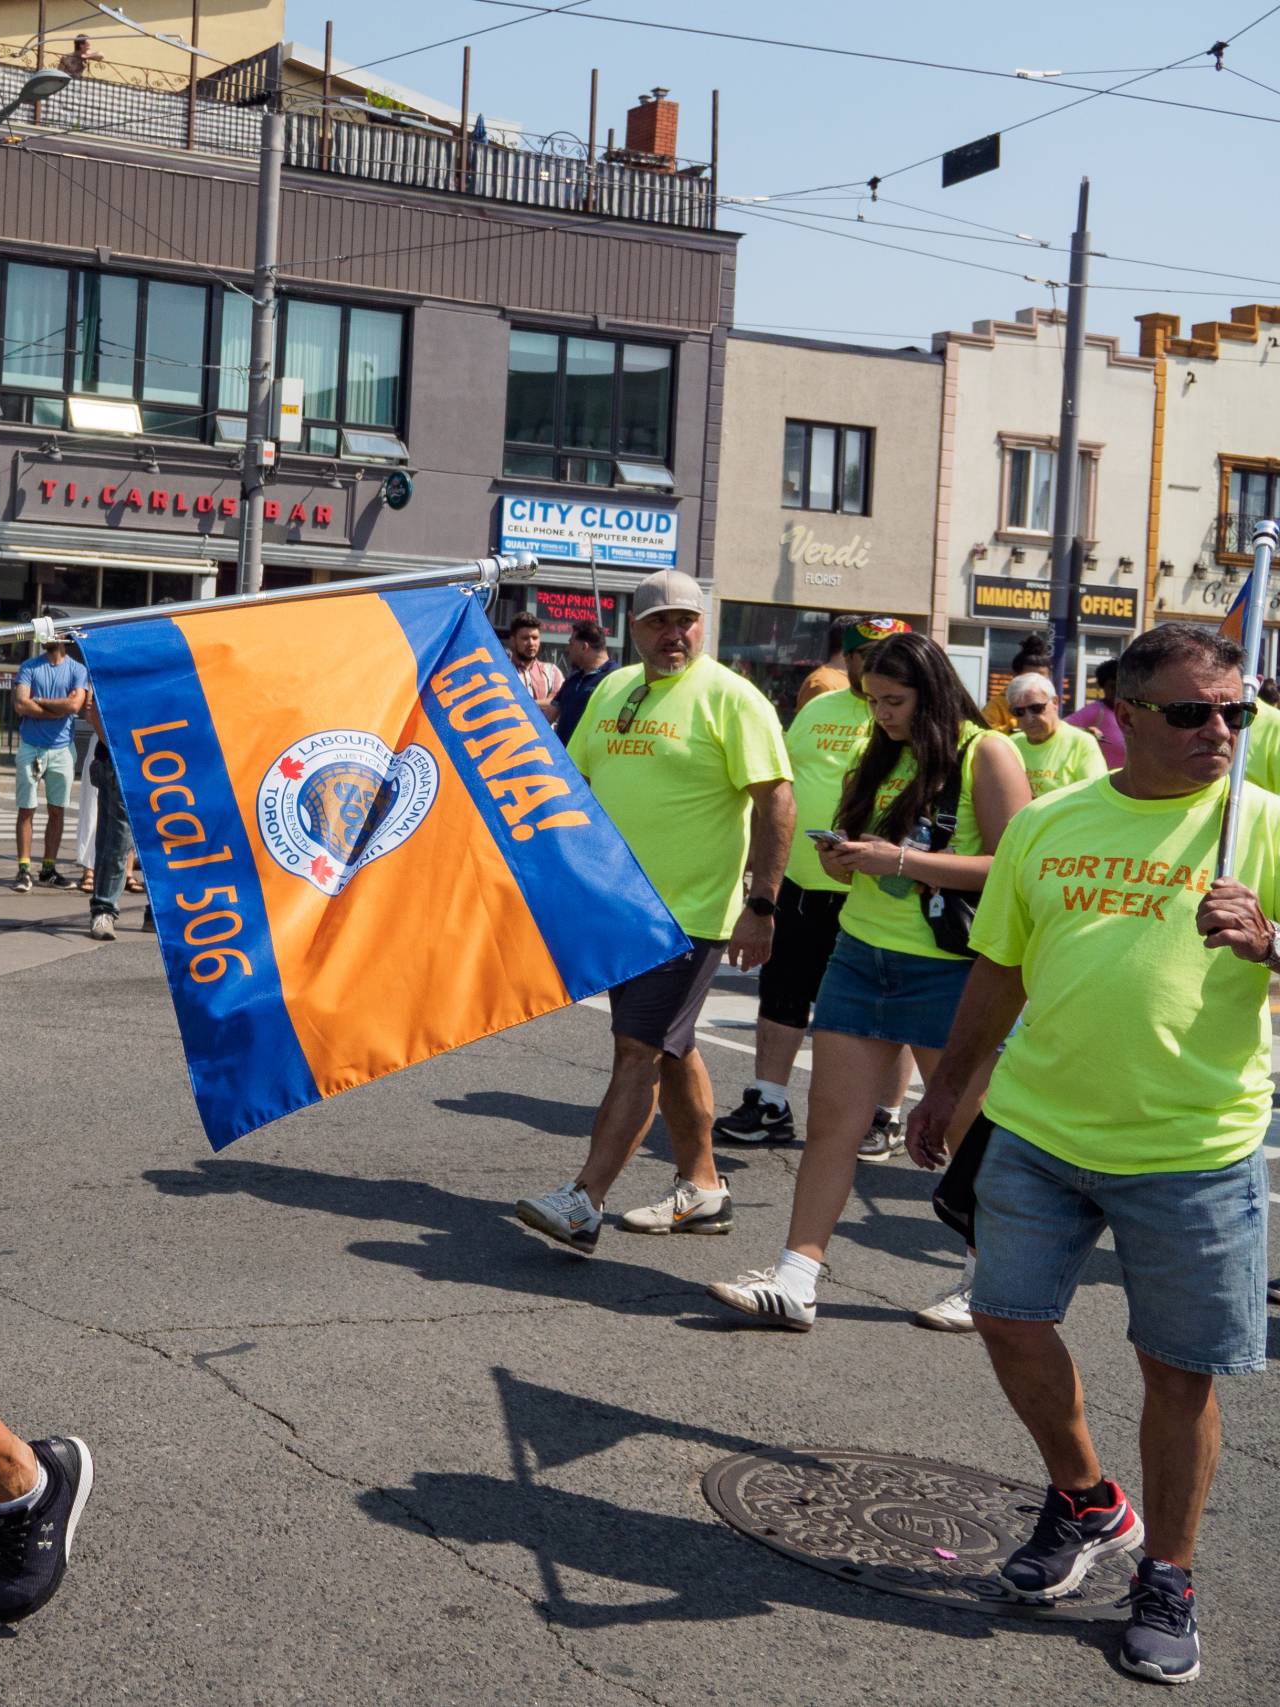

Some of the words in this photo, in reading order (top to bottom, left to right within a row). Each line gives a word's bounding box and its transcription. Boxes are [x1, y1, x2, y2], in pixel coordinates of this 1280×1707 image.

[263, 500, 334, 524] BAR
[509, 499, 573, 525] CITY
[580, 506, 672, 534] CLOUD
[504, 539, 540, 551] QUALITY
[507, 524, 530, 533] CELL
[533, 527, 566, 537] PHONE
[577, 531, 628, 542] COMPUTER
[630, 536, 665, 545] REPAIR
[780, 526, 872, 569] Verdi
[805, 572, 842, 586] FLORIST
[547, 606, 562, 618] TO
[567, 594, 615, 609] PRINTNG
[976, 586, 1051, 610] IMMIGRAT
[1081, 595, 1133, 617] OFFICE
[607, 739, 656, 756] WEEK
[816, 737, 854, 752] WEE
[333, 752, 385, 770] JUSTICE
[131, 720, 233, 870] Local
[388, 748, 431, 838] NTERNATIONAL
[264, 787, 300, 866] TORONTO
[286, 792, 312, 851] STRENGTH
[1039, 855, 1211, 894] PORTUGAL
[1062, 885, 1171, 921] WEEK
[176, 885, 253, 984] 506
